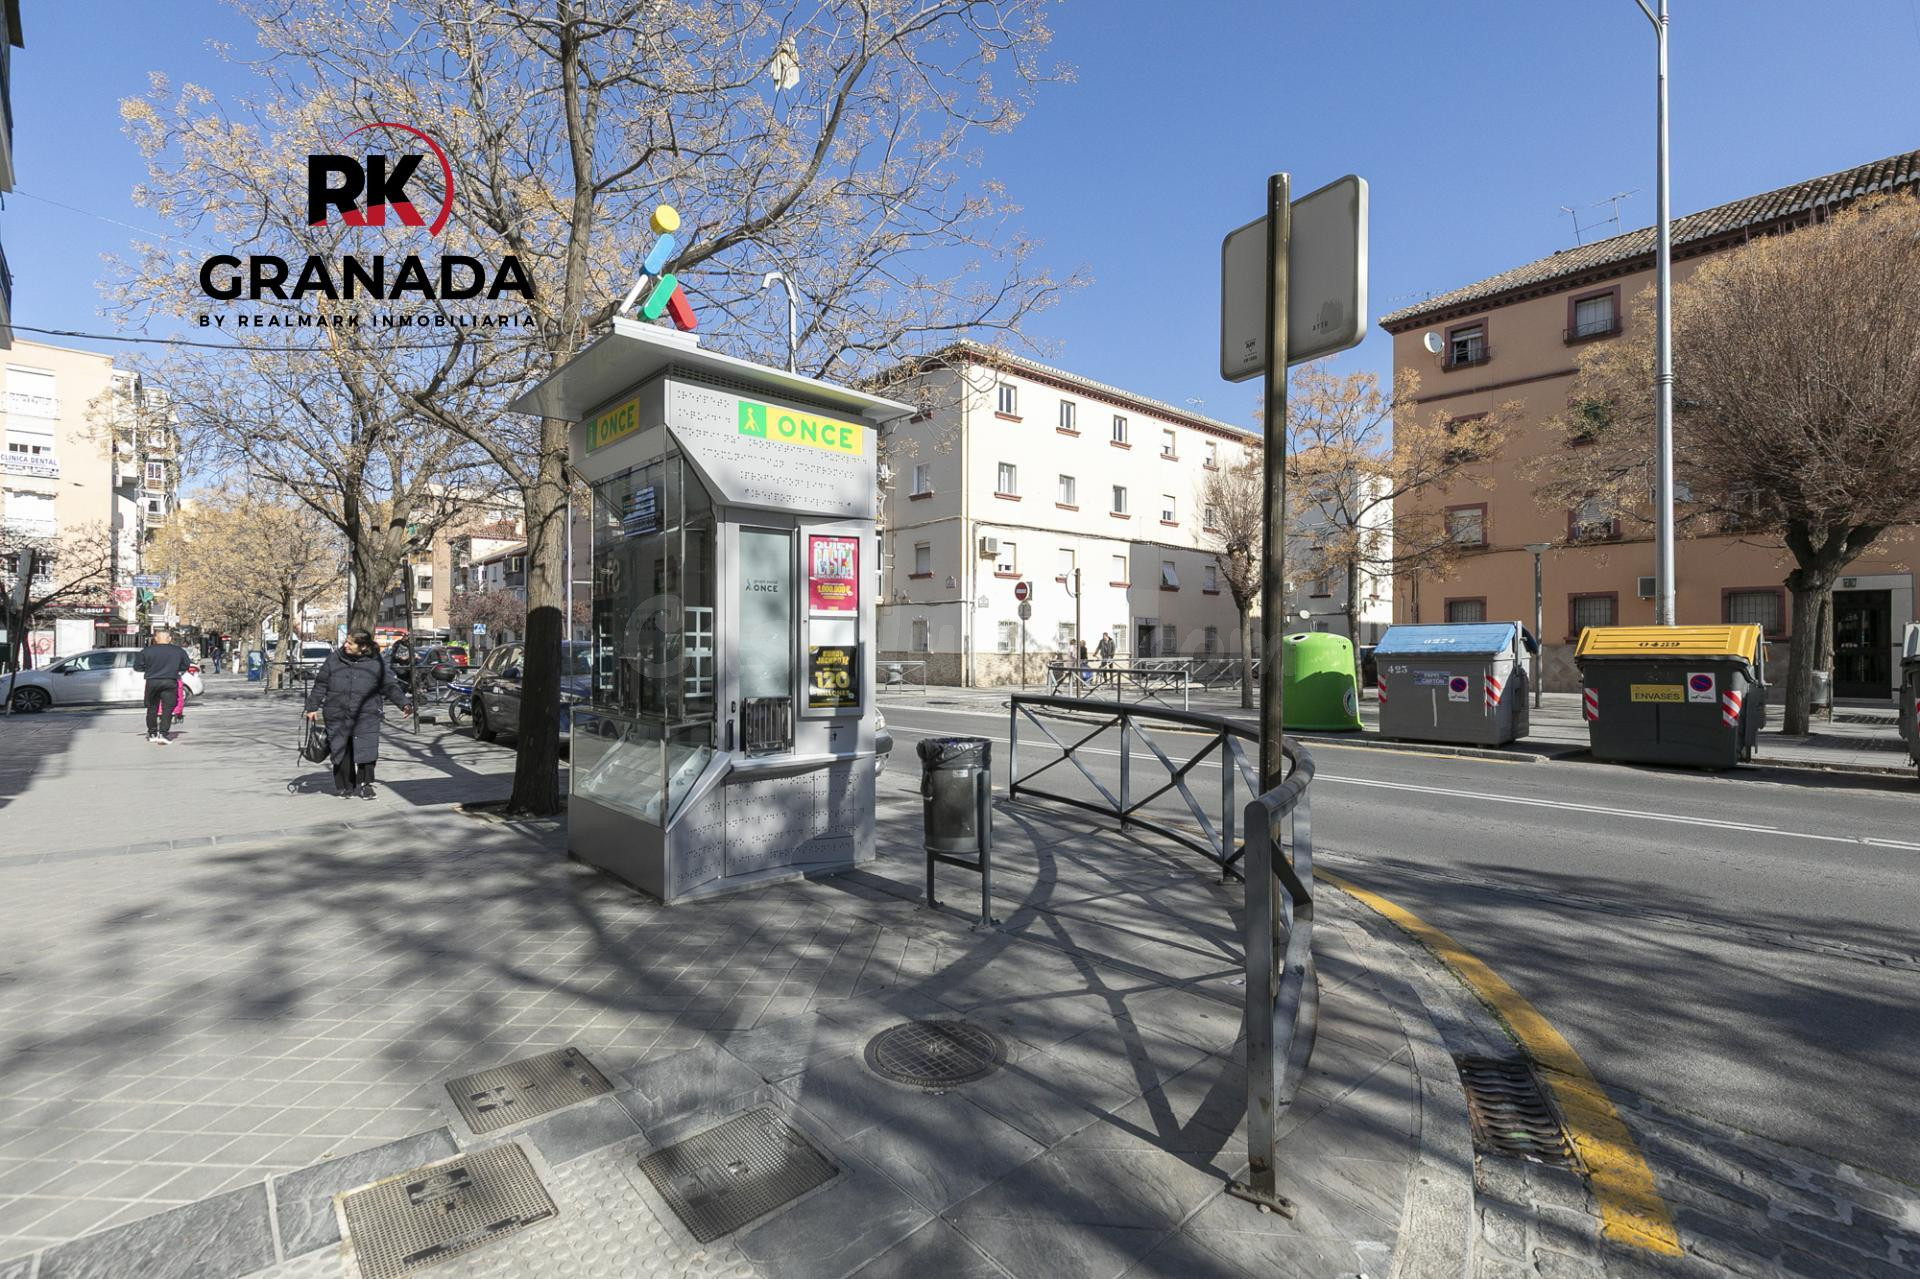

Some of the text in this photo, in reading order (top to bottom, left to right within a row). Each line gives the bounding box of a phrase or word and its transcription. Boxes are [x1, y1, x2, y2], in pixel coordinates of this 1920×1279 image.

[600, 406, 636, 440] ONCE
[778, 415, 853, 448] ONCE
[31, 457, 57, 466] DENTAL
[815, 671, 850, 689] 120
[1634, 692, 1680, 700] ENVASES
